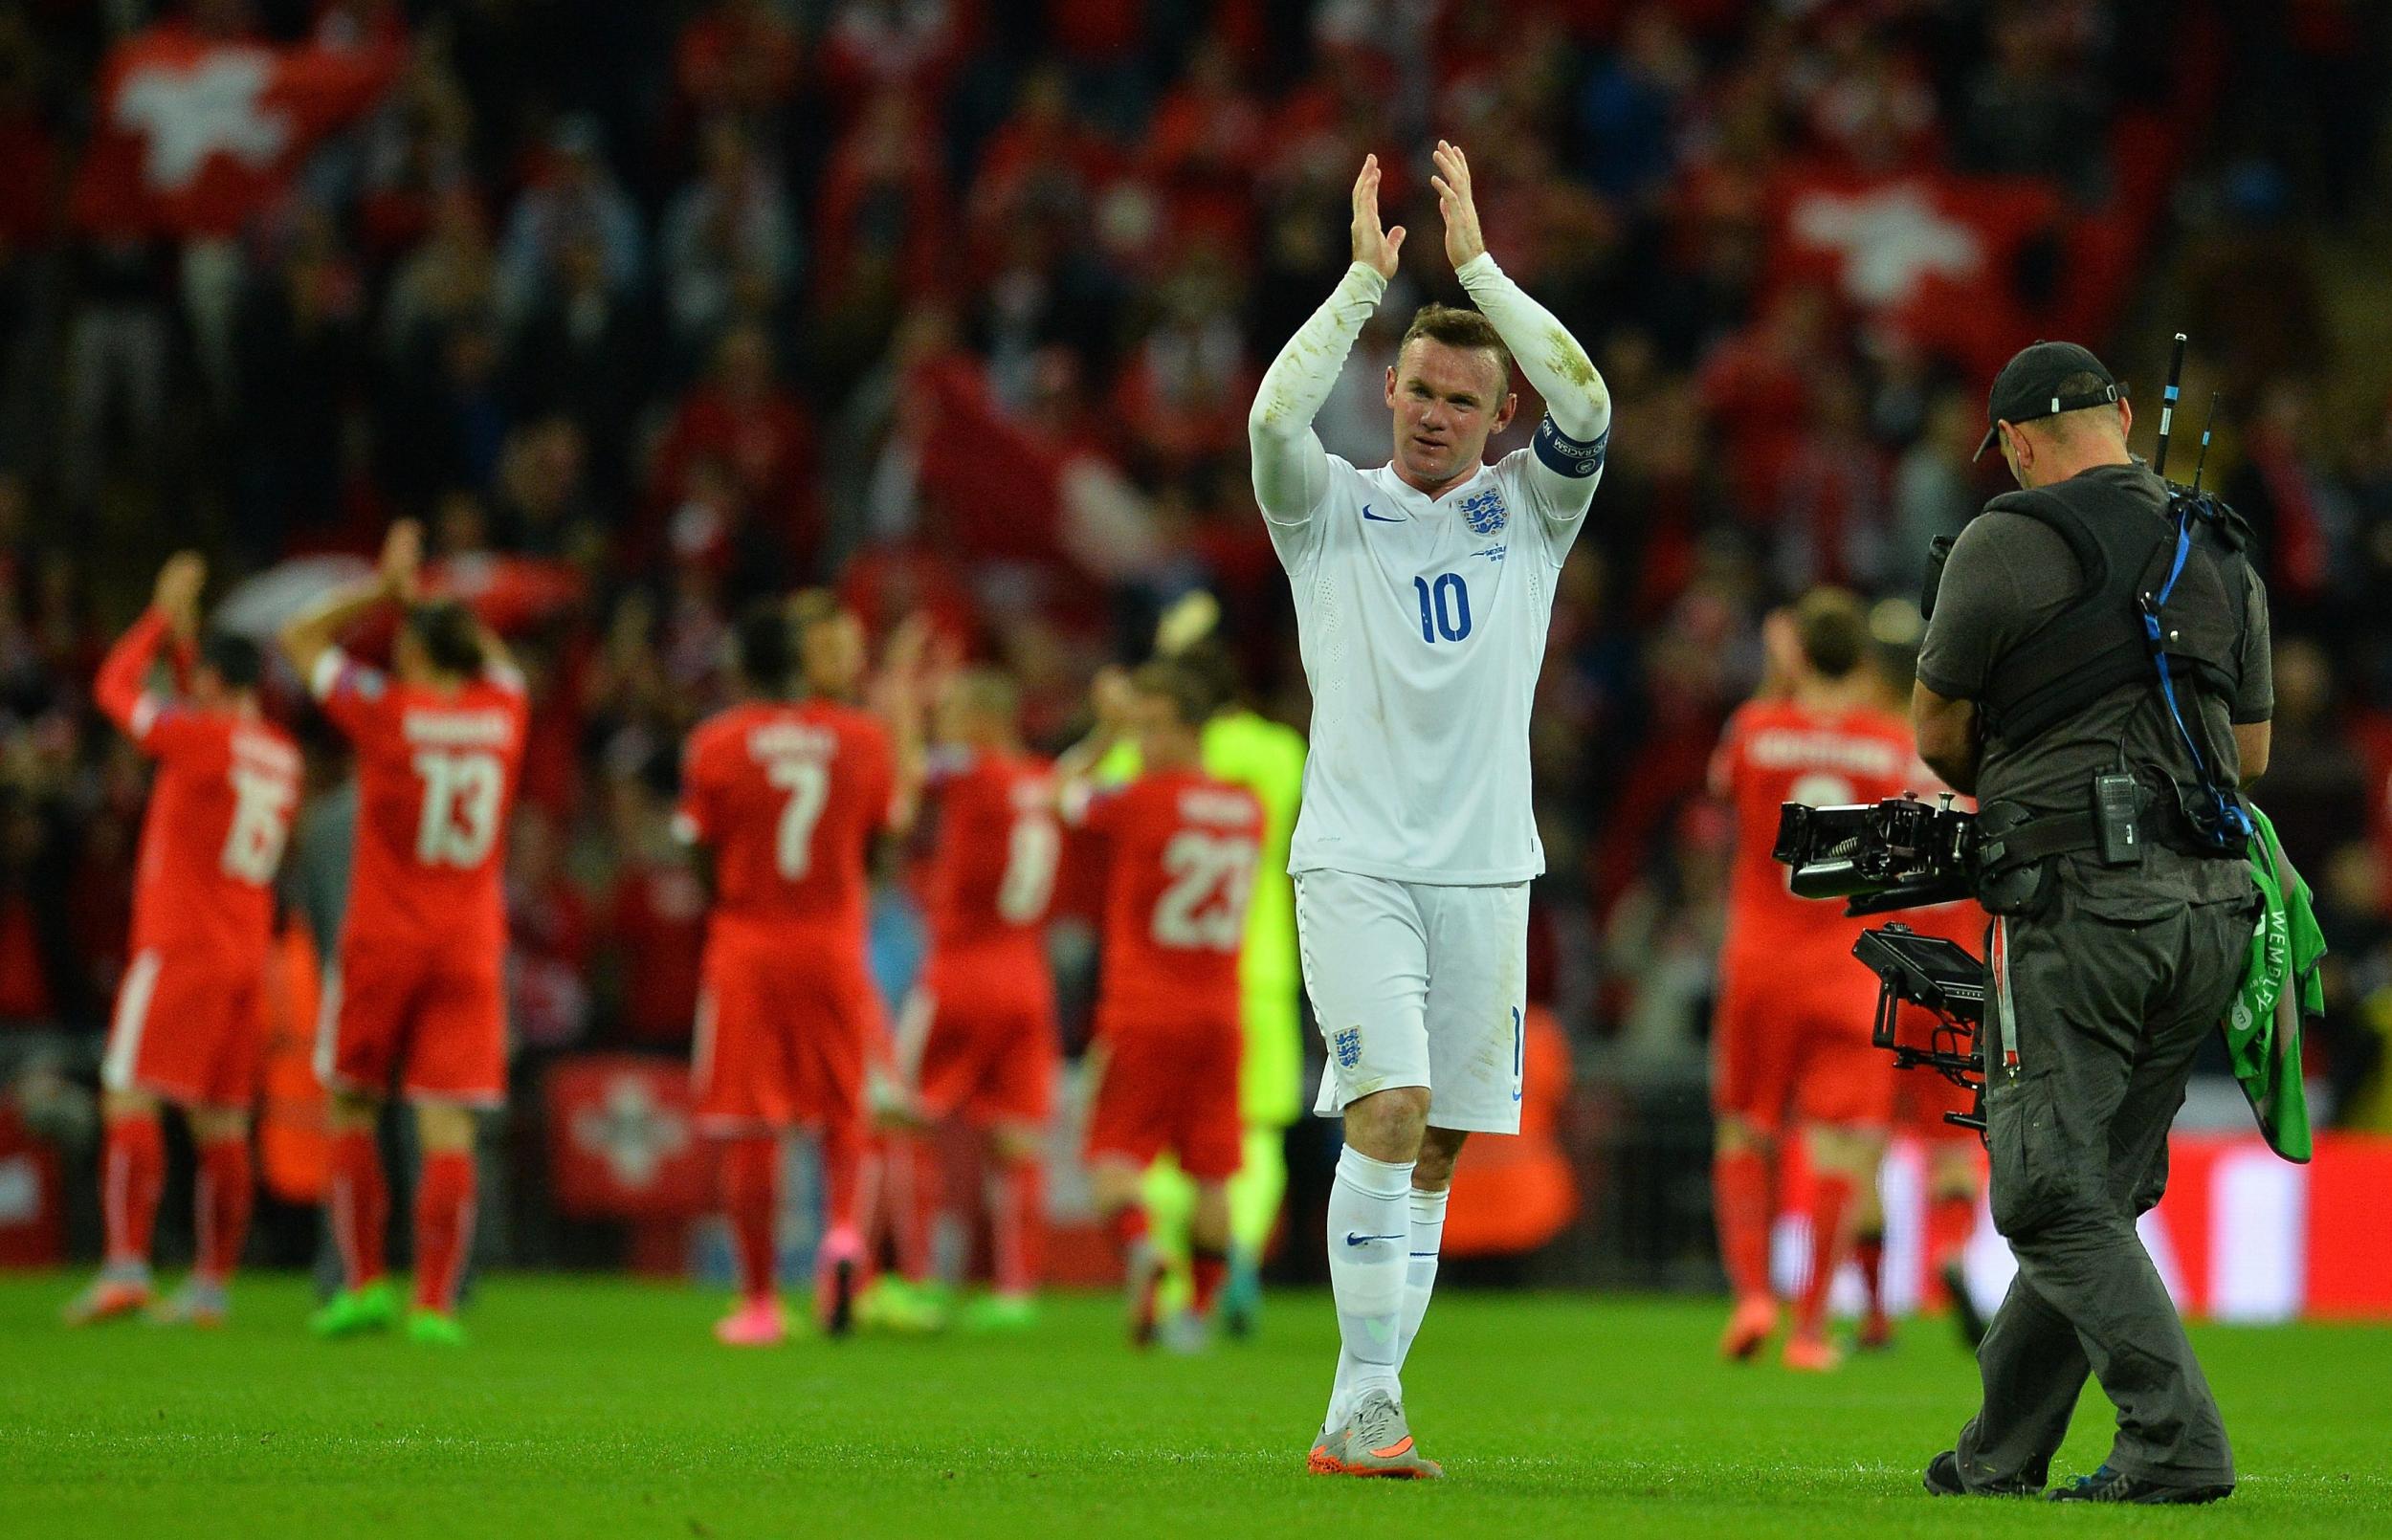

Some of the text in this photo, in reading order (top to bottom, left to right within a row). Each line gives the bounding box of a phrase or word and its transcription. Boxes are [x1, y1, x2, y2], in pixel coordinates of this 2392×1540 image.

[1554, 438, 1592, 457] RACISM
[1413, 572, 1472, 644] 10
[413, 749, 504, 869] 13
[767, 757, 830, 882] 7
[1150, 830, 1259, 953] 23
[2255, 911, 2286, 1013] WEMBLEY
